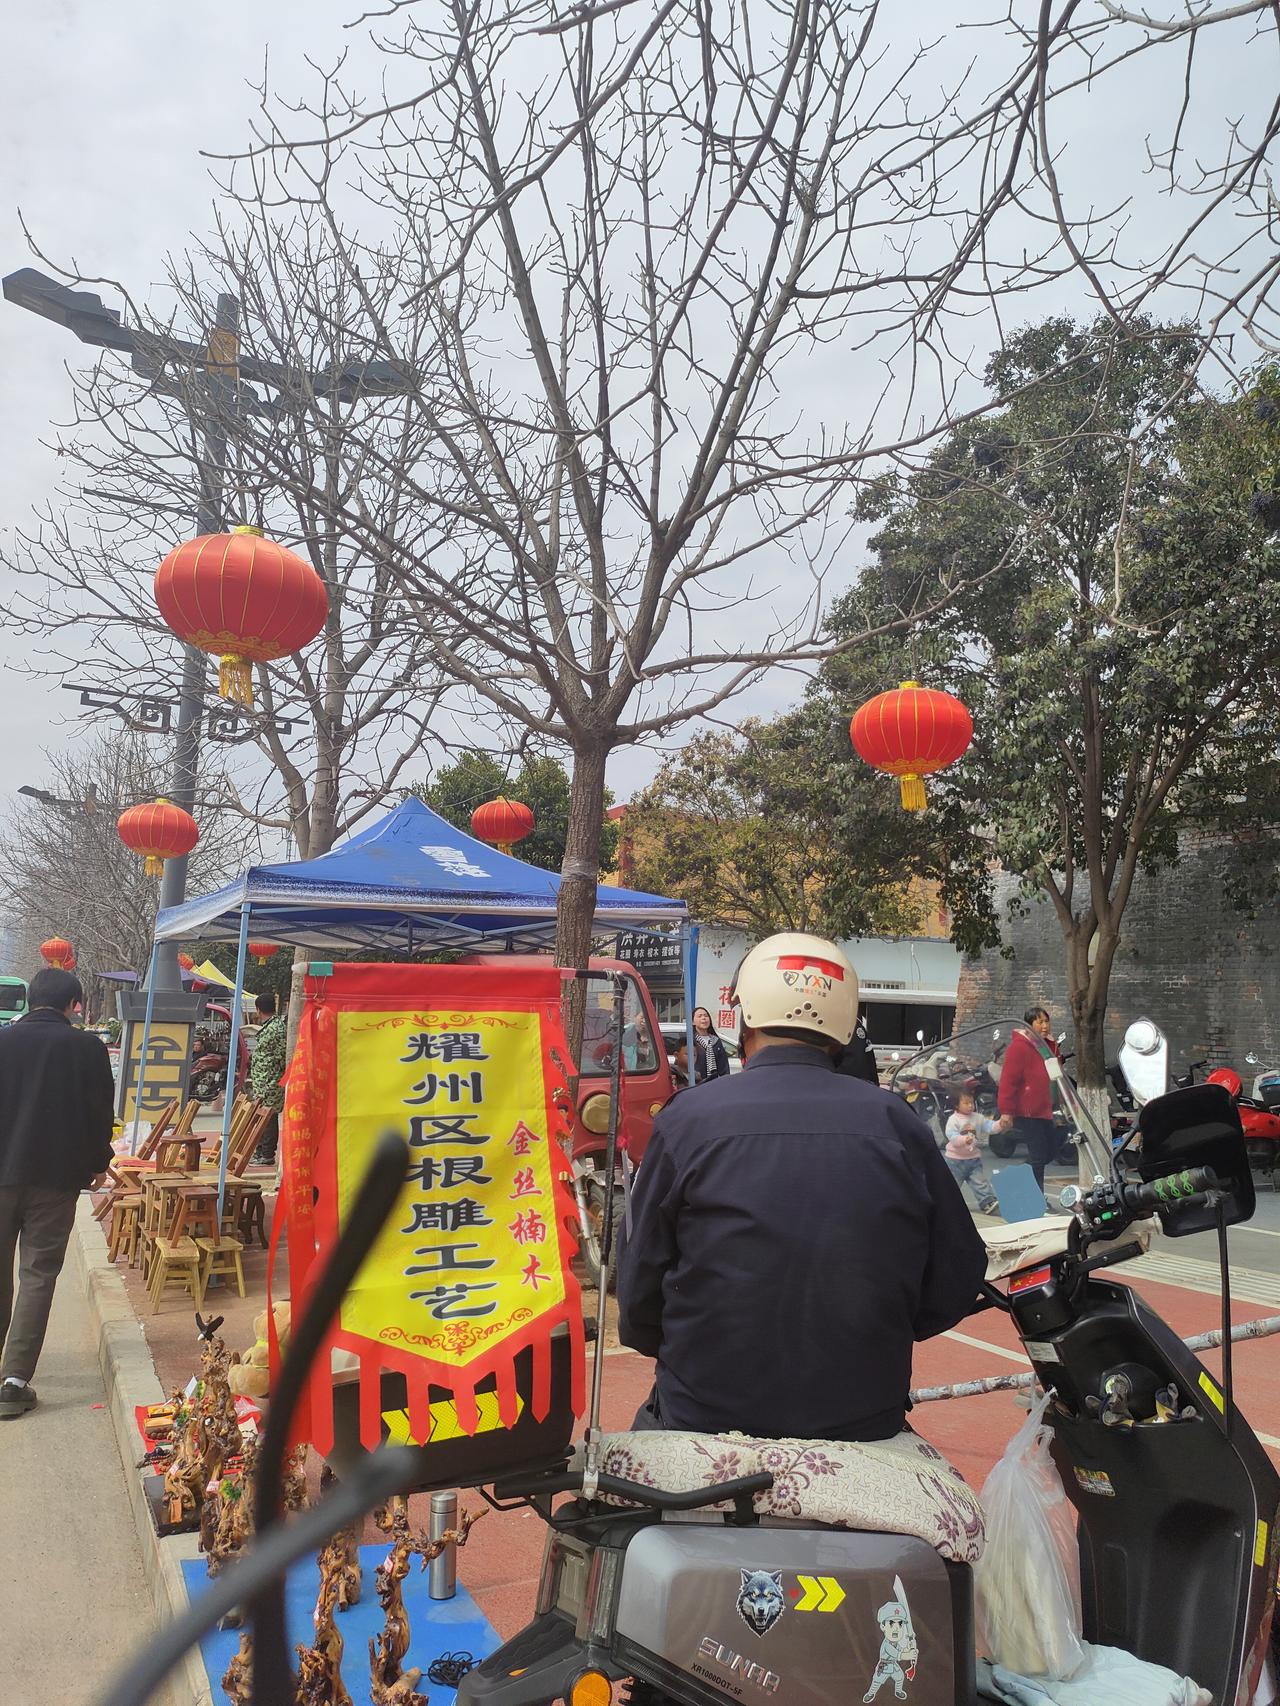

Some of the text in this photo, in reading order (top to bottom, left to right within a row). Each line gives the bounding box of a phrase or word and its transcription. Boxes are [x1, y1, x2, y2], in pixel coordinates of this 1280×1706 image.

[718, 986, 736, 1029] 花圈
[400, 1033, 497, 1320] 耀州区根雕工艺
[507, 1121, 551, 1290] 金丝楠木
